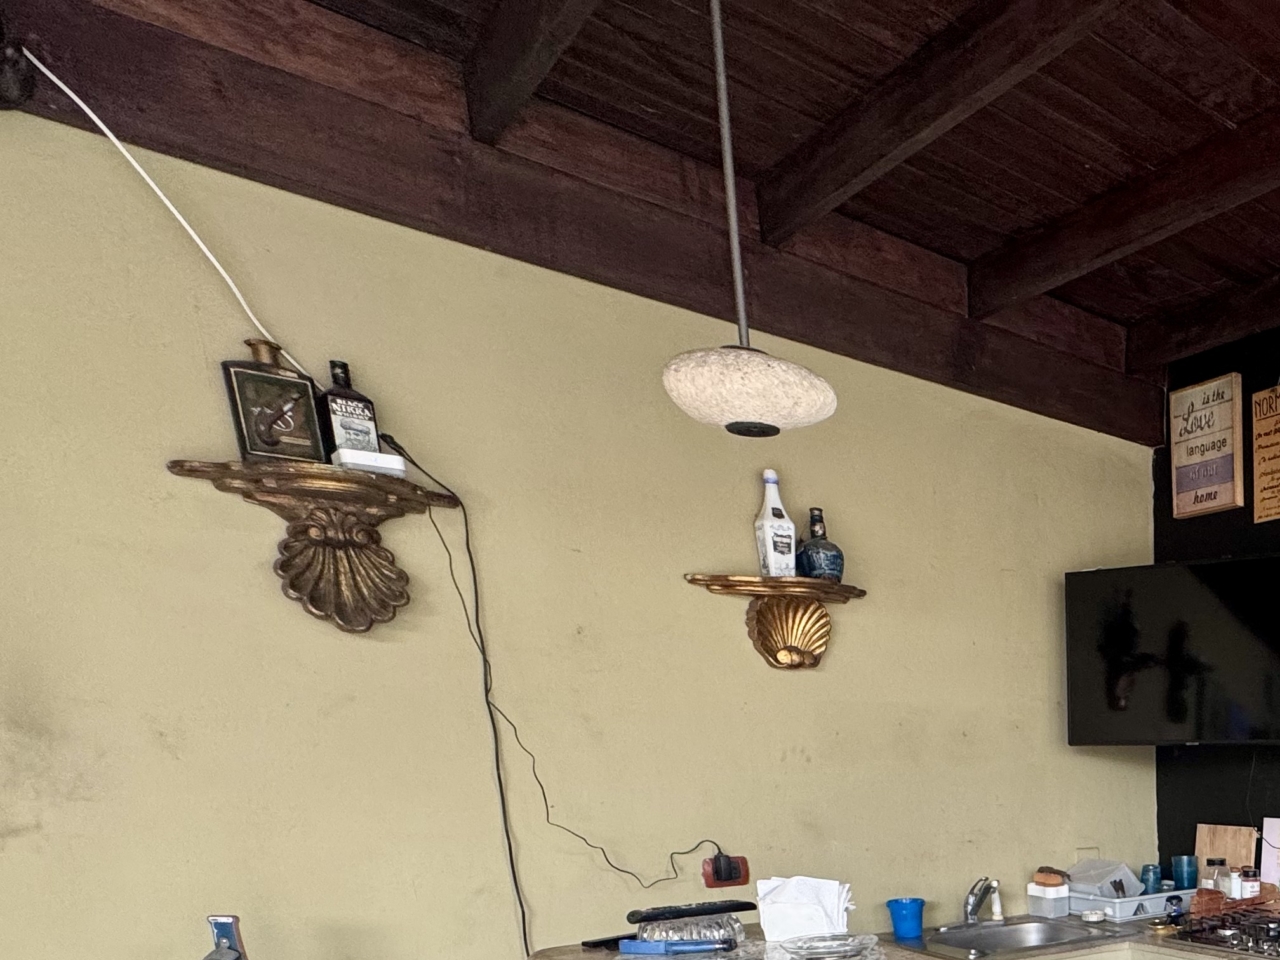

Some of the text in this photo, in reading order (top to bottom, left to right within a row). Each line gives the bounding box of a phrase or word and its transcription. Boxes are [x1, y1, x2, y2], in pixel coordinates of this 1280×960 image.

[336, 399, 364, 408] BLACK
[1202, 389, 1225, 405] is the
[331, 402, 372, 418] NIKKA
[1179, 401, 1215, 437] Love
[1187, 438, 1227, 457] language
[1193, 491, 1218, 505] home
